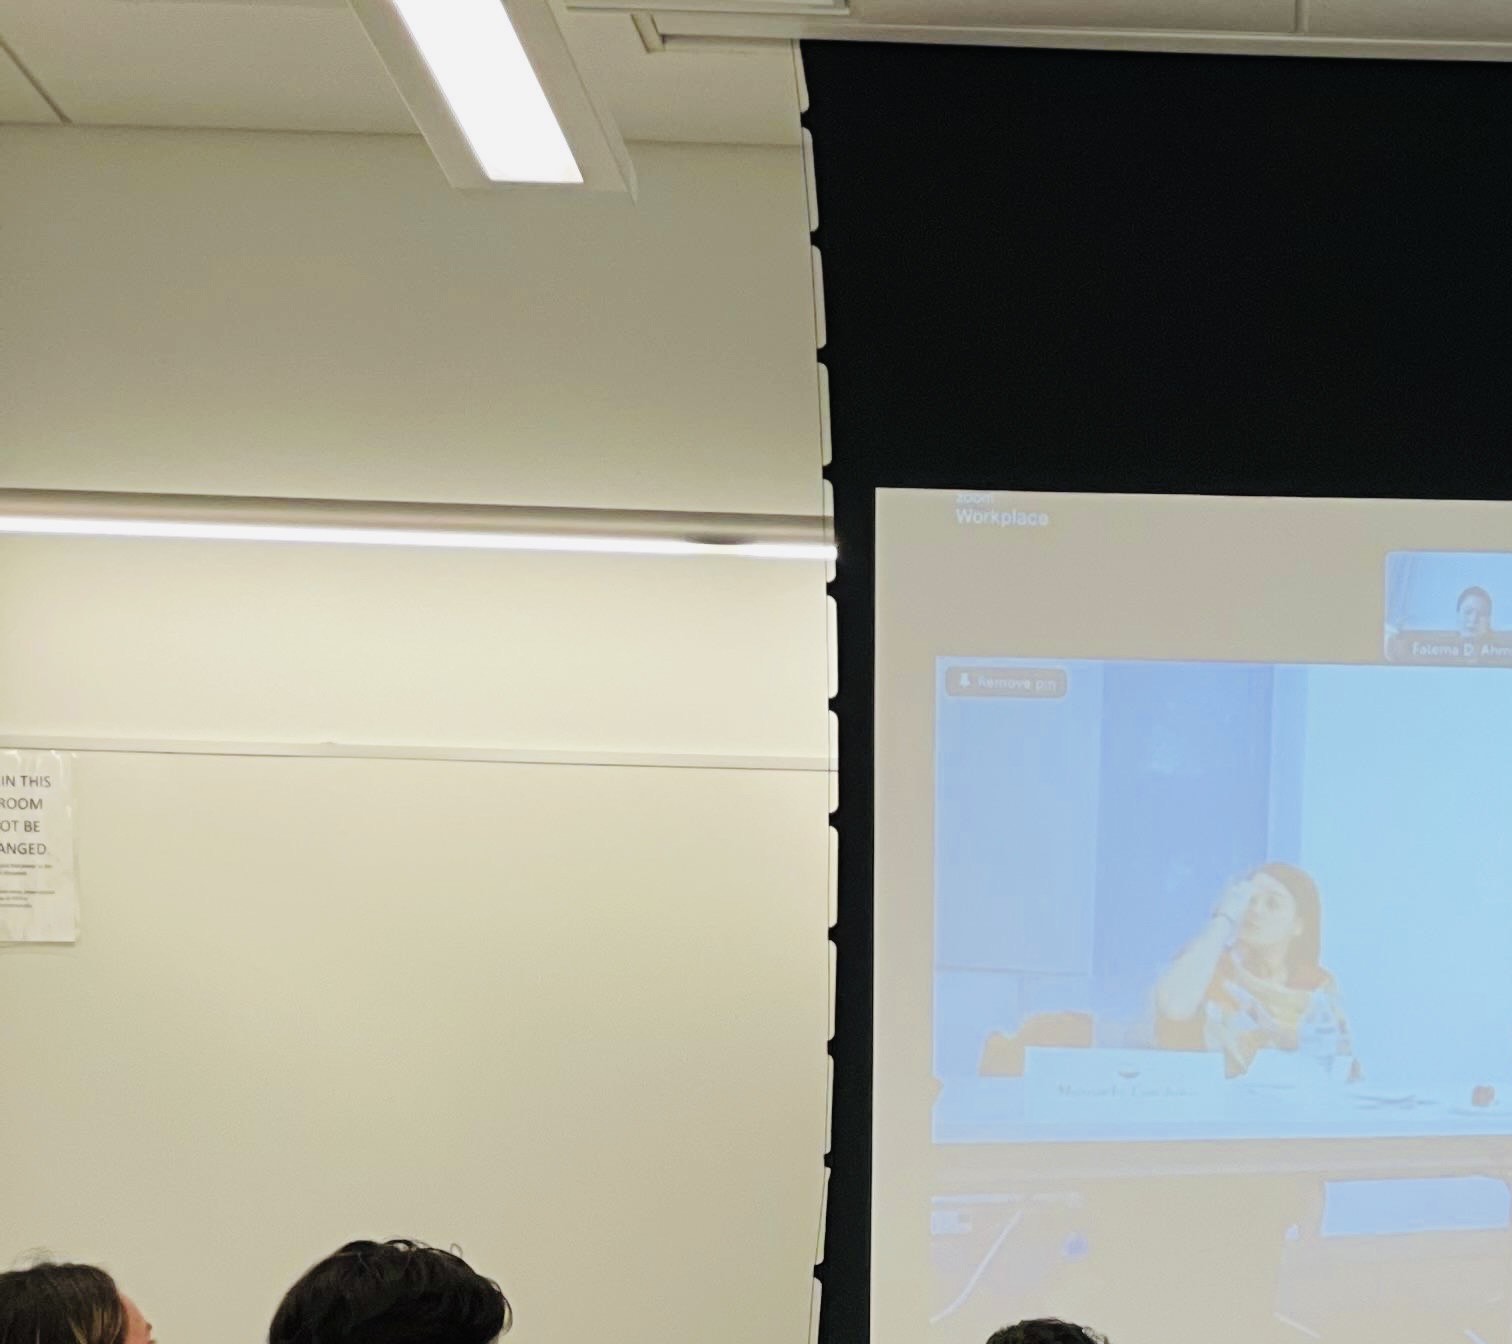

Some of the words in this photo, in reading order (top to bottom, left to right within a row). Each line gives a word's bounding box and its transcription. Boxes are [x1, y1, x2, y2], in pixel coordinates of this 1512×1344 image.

[956, 508, 1050, 528] Workplace
[20, 775, 51, 788] THIS
[24, 820, 40, 833] BE
